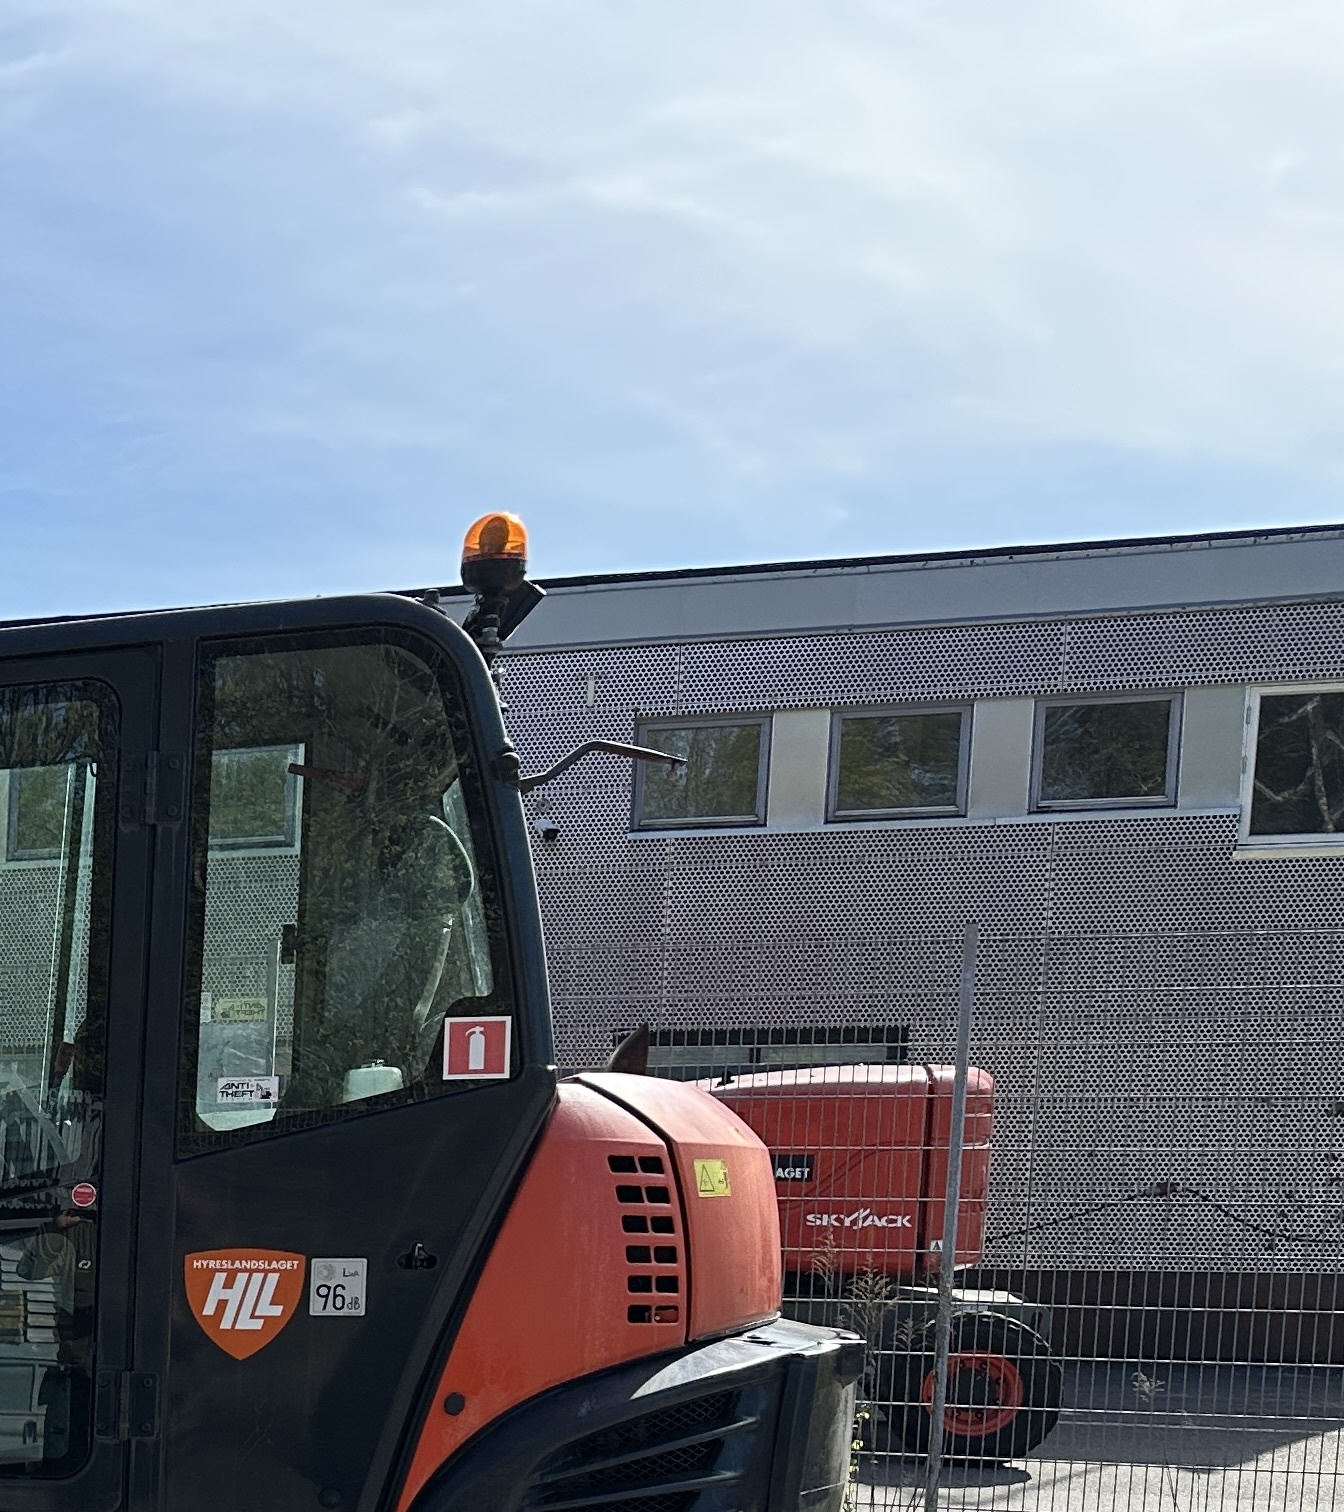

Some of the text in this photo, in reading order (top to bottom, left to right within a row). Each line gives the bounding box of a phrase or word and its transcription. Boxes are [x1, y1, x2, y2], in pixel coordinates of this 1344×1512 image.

[219, 1090, 255, 1098] THEFT
[806, 1207, 912, 1230] SKYJACK
[193, 1259, 299, 1271] HYRESLANDSLAGET
[202, 1272, 284, 1330] HLL
[316, 1283, 361, 1311] 96 dB
